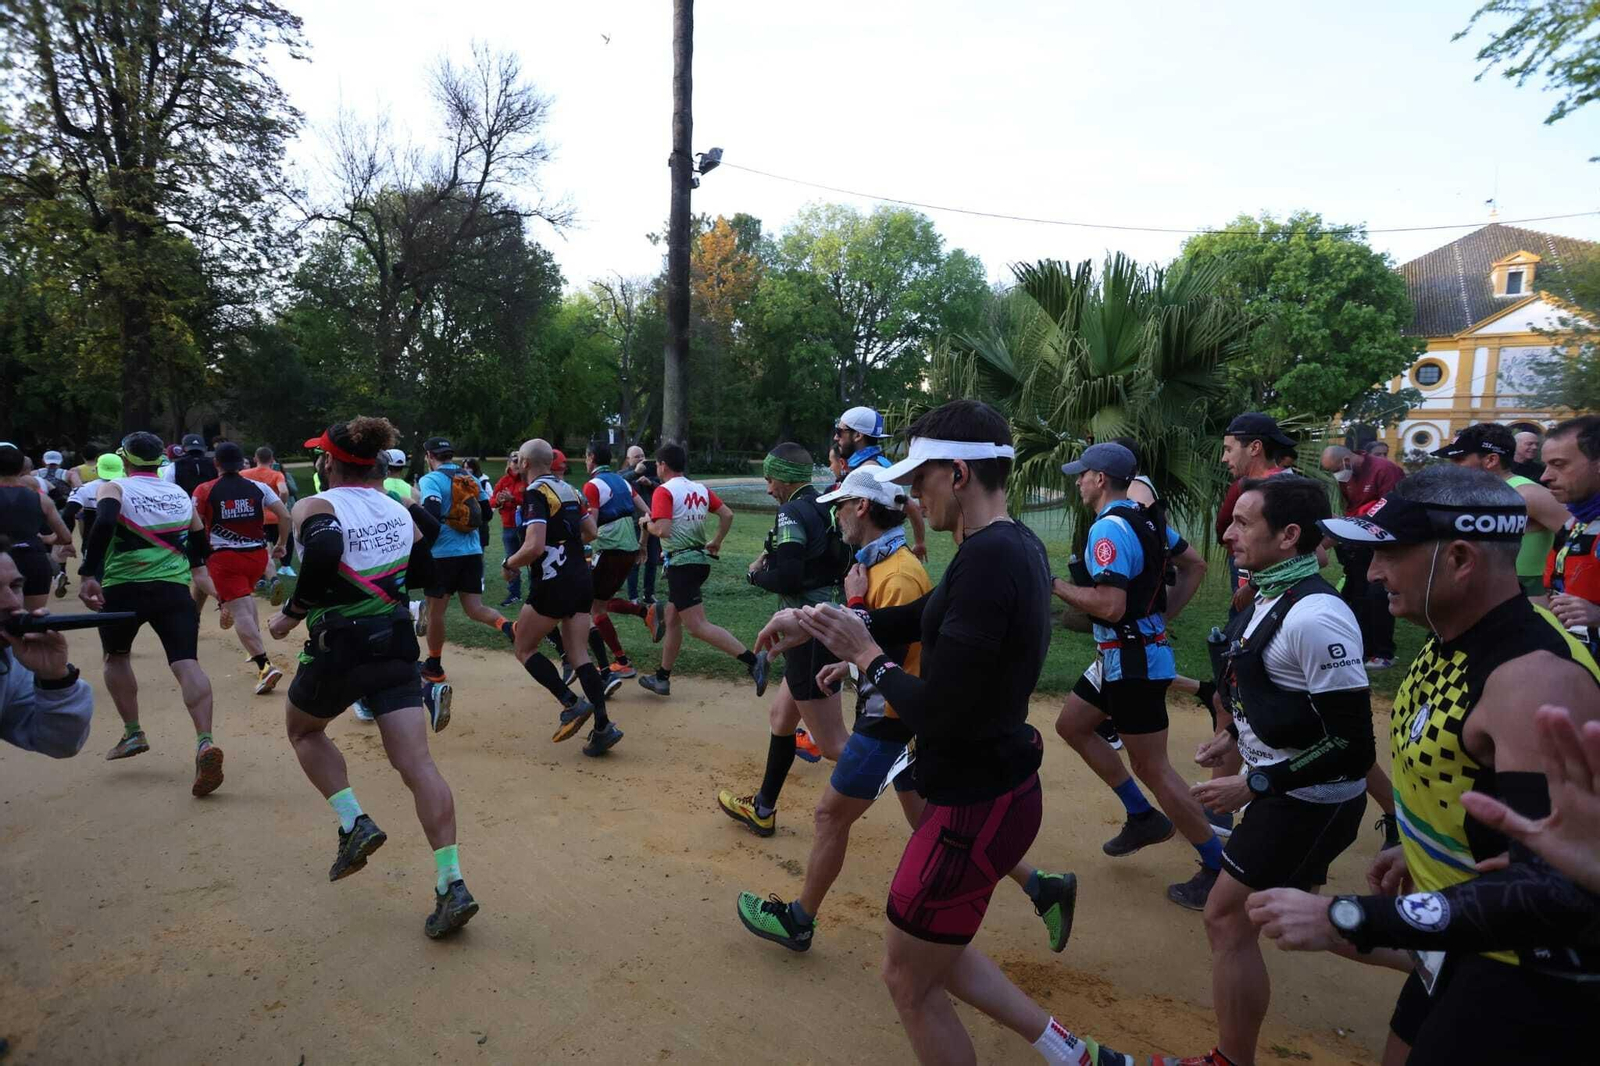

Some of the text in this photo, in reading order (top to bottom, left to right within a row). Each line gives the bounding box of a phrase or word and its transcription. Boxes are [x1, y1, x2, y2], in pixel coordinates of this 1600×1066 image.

[347, 516, 407, 539] FUNCIONAL
[1454, 514, 1528, 533] COMP
[349, 530, 400, 553] FITNESS
[1320, 658, 1361, 671] asodena
